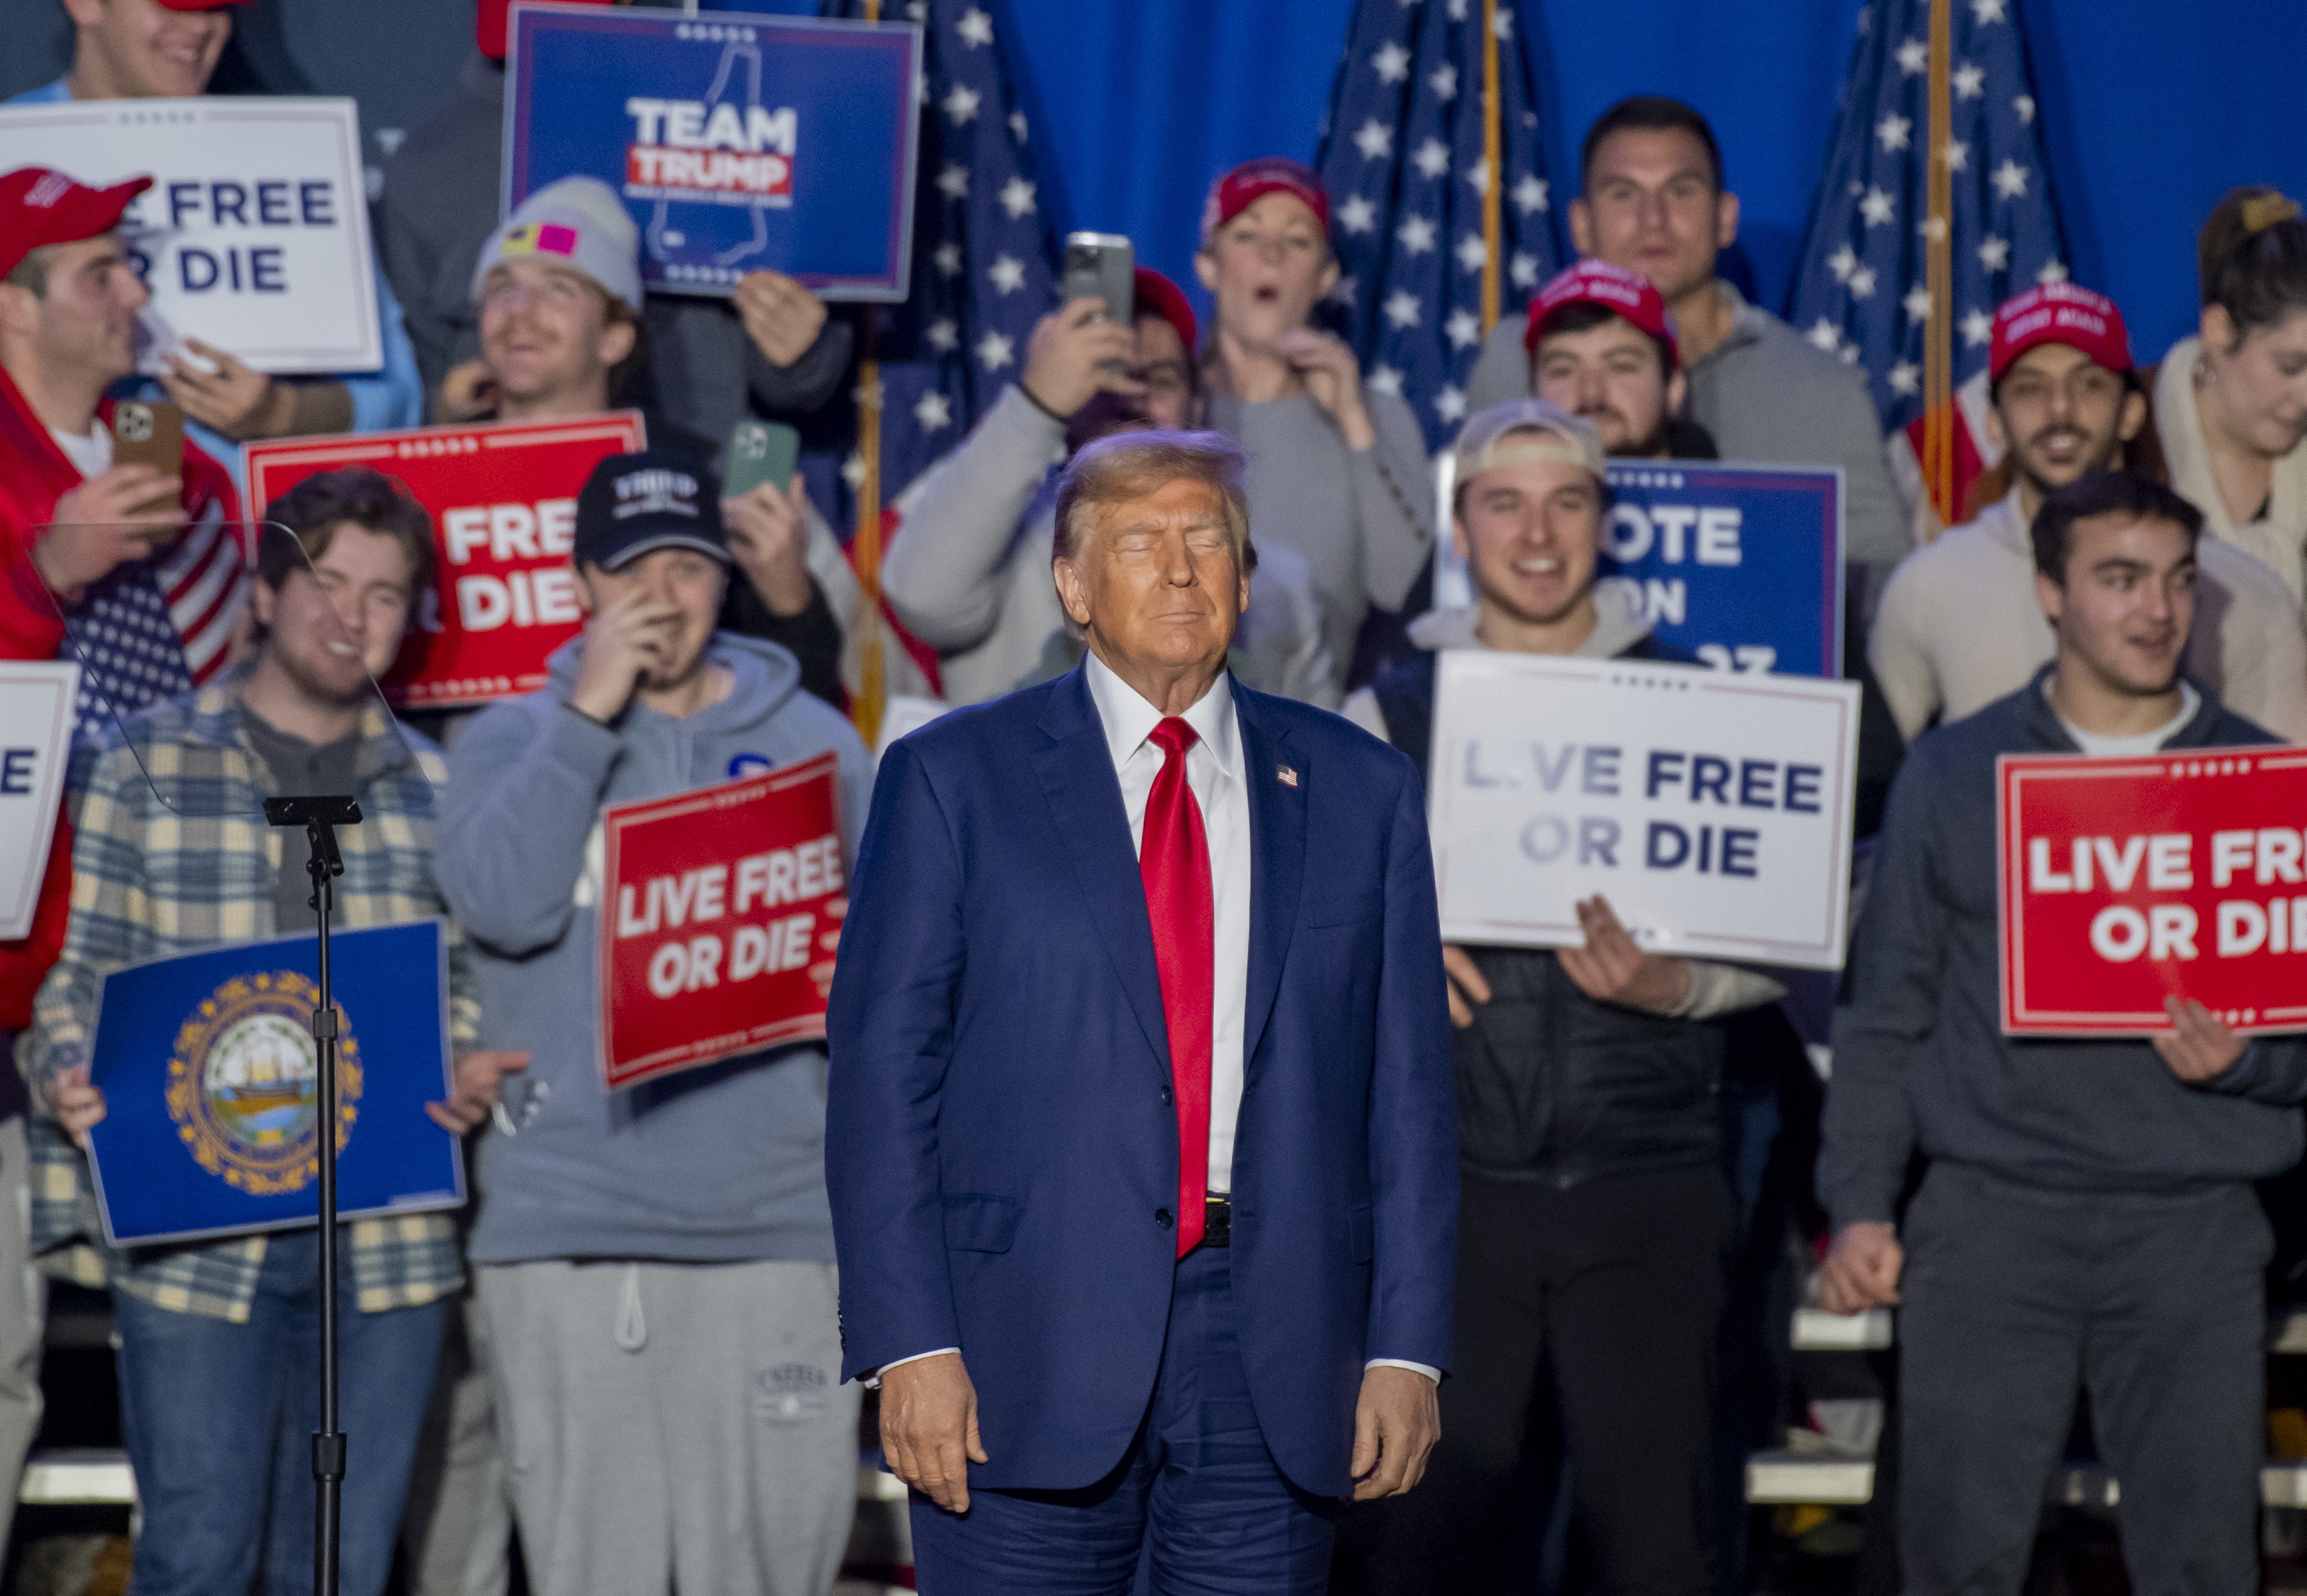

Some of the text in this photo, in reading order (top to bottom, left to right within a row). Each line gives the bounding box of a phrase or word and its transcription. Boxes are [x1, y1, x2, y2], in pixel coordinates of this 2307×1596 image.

[626, 96, 797, 154] TEAM
[631, 145, 788, 195] TRUMP
[167, 180, 337, 228] FREE
[177, 246, 288, 294] DIE
[441, 497, 578, 566] FRE
[1598, 502, 1743, 566] OTE
[455, 567, 581, 633] DIE
[1463, 736, 1823, 815] LVE FREE
[1518, 812, 1759, 880] OR DIE
[2029, 826, 2307, 893] LIVE FR
[617, 833, 844, 938] LIVE FREE
[647, 910, 816, 999] OR DIE
[2089, 903, 2199, 964] OR
